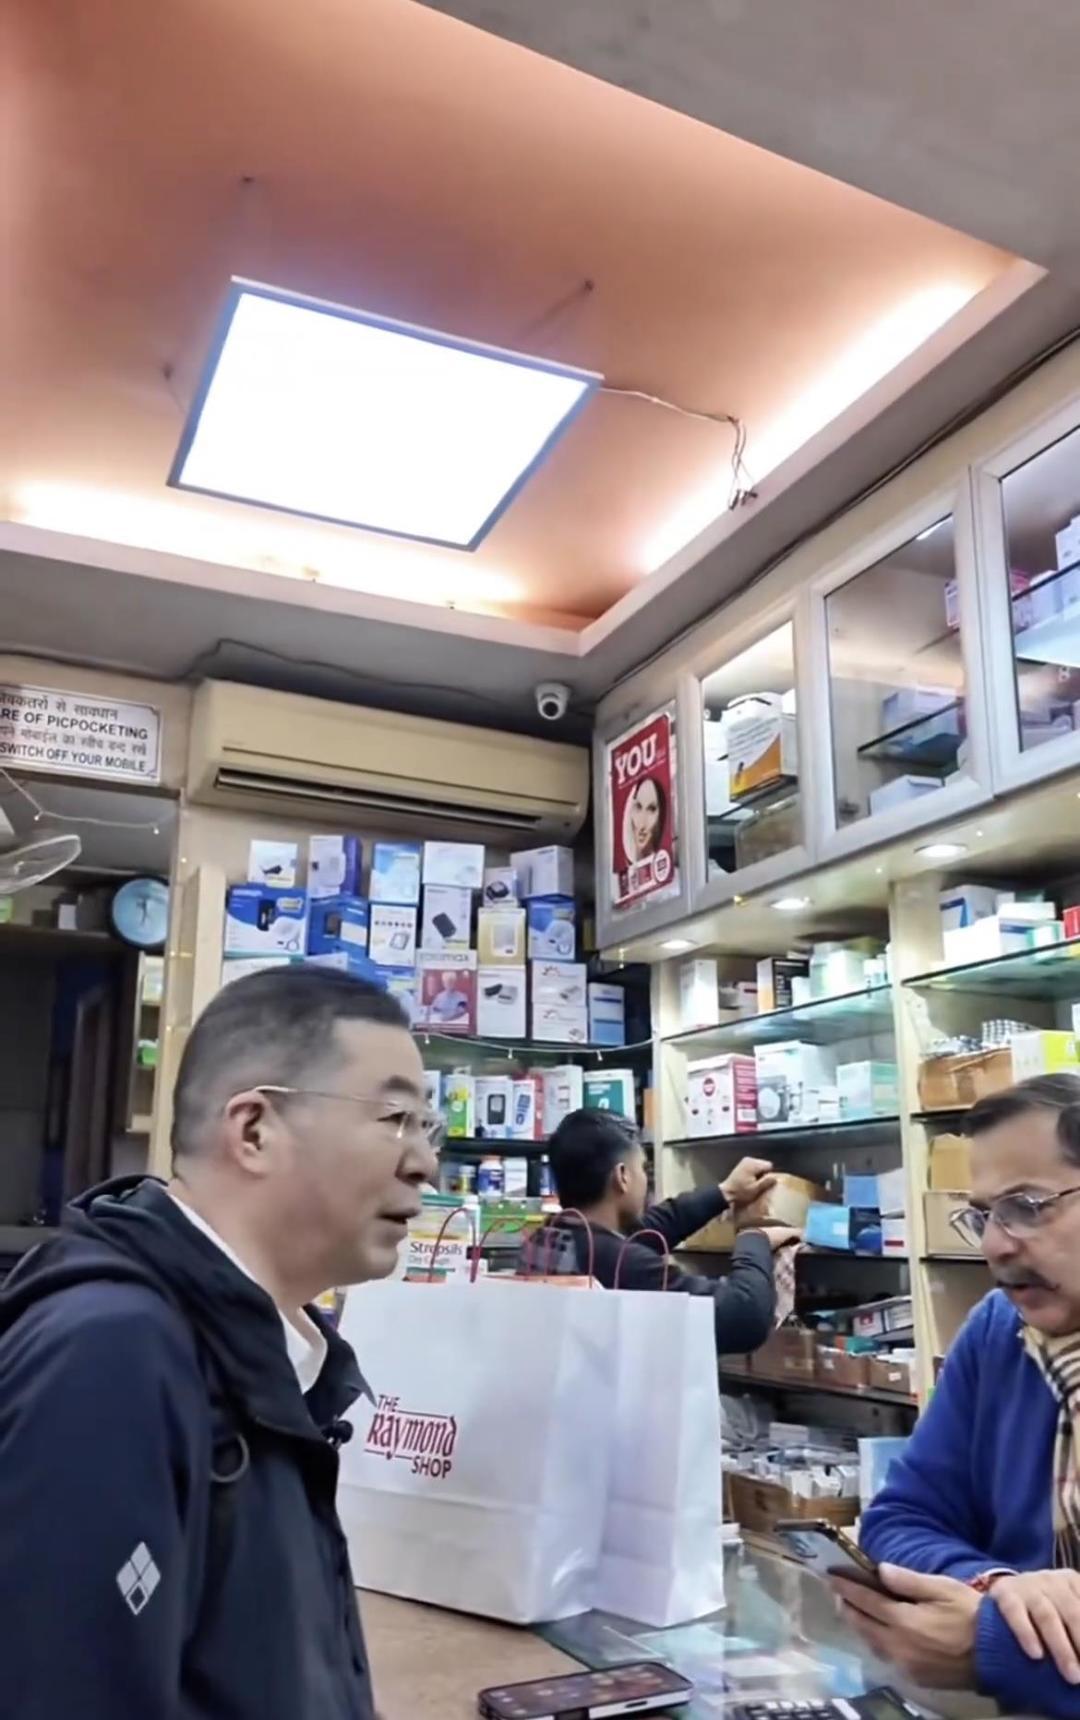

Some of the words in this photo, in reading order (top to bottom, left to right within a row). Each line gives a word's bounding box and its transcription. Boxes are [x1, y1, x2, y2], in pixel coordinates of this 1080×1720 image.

[0, 708, 19, 721] RE
[24, 711, 44, 724] OF
[47, 715, 148, 740] PICPOCKETING
[0, 742, 44, 758] SWITCH
[46, 748, 68, 760] OFF
[71, 752, 103, 765] YOUR
[105, 757, 146, 772] MOBILE
[614, 733, 658, 785] YOU
[378, 1394, 400, 1412] THE
[366, 1413, 457, 1459] Raymond
[411, 1455, 452, 1479] SHOP
